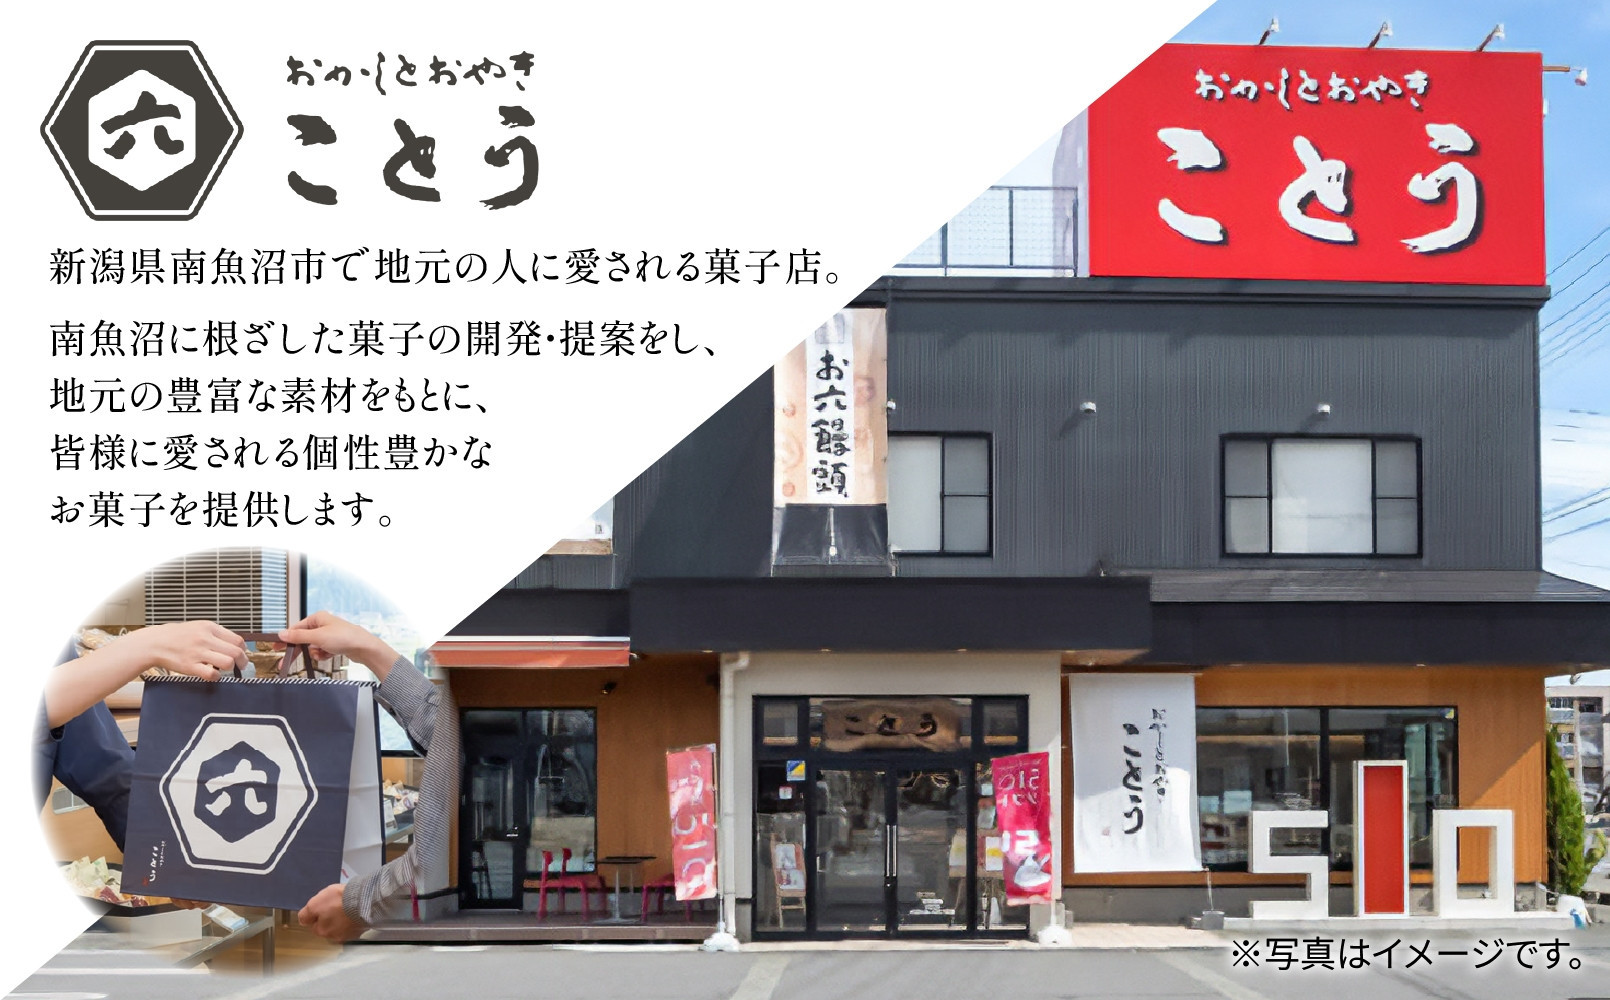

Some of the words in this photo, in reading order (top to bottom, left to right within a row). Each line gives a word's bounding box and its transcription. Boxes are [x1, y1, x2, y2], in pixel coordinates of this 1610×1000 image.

[1156, 123, 1480, 253] ことう
[844, 712, 938, 738] ことう
[204, 757, 269, 817] 六
[1122, 723, 1144, 835] ことう
